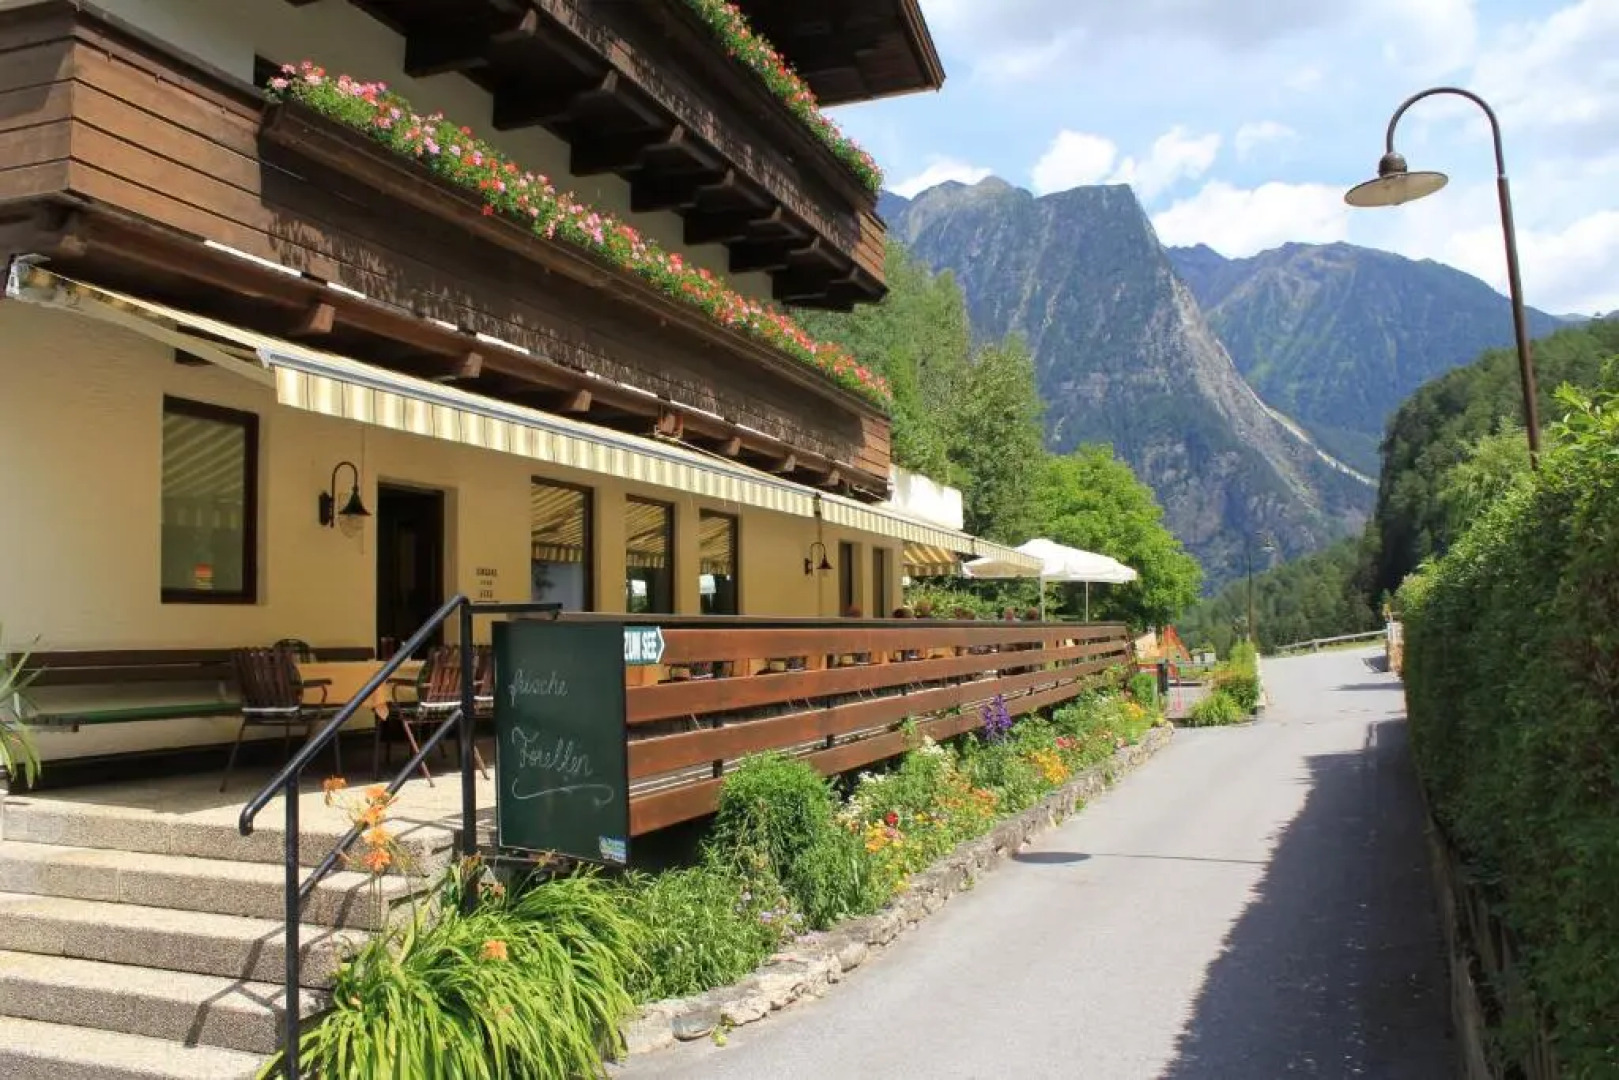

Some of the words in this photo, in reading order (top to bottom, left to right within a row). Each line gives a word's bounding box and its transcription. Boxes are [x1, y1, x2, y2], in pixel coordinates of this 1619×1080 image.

[642, 631, 656, 659] SEE
[508, 668, 568, 707] frische
[512, 726, 593, 777] Forellen
